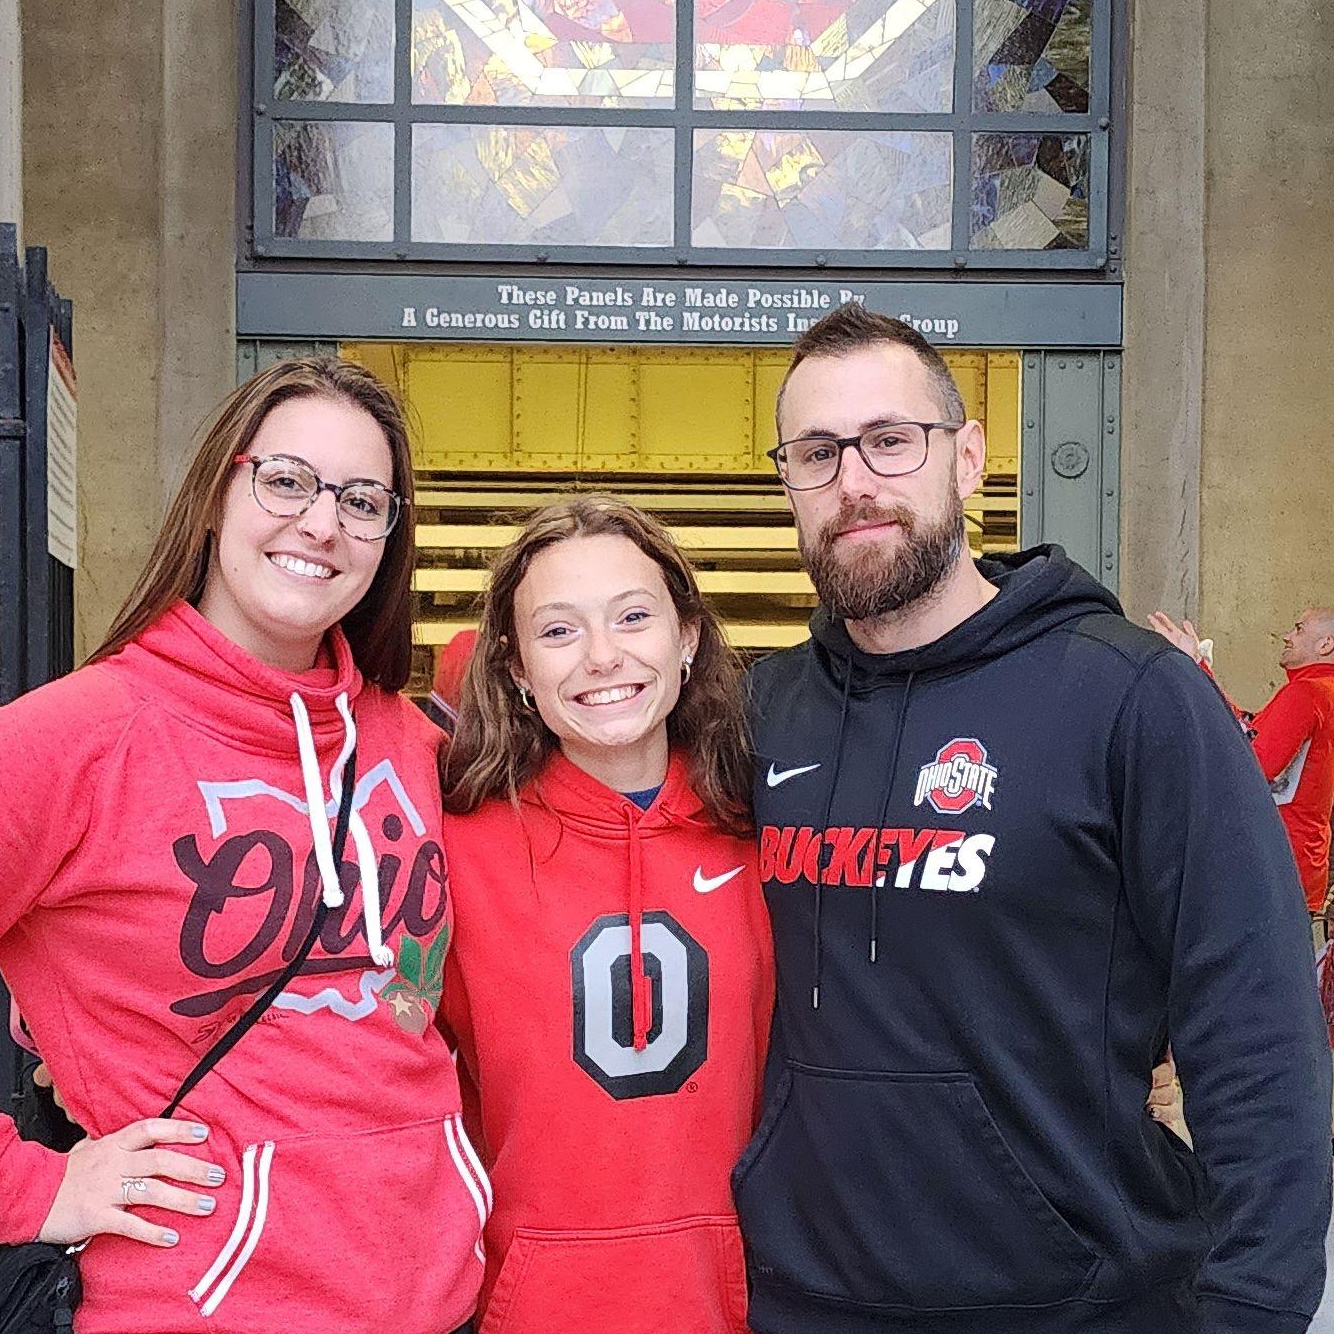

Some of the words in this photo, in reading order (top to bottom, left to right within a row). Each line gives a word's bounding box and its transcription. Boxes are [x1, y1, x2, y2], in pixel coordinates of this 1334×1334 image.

[497, 285, 557, 305] These
[566, 286, 633, 307] Panels
[642, 287, 676, 307] Are
[684, 288, 739, 308] Made
[747, 288, 831, 309] Possible
[401, 307, 417, 327] A
[425, 307, 520, 329] Generous
[528, 309, 567, 330] Gift
[574, 310, 629, 330] From
[635, 311, 674, 331] The
[682, 312, 778, 332] Motorists
[949, 755, 998, 810] STATE
[760, 825, 996, 892] BUCKEYES
